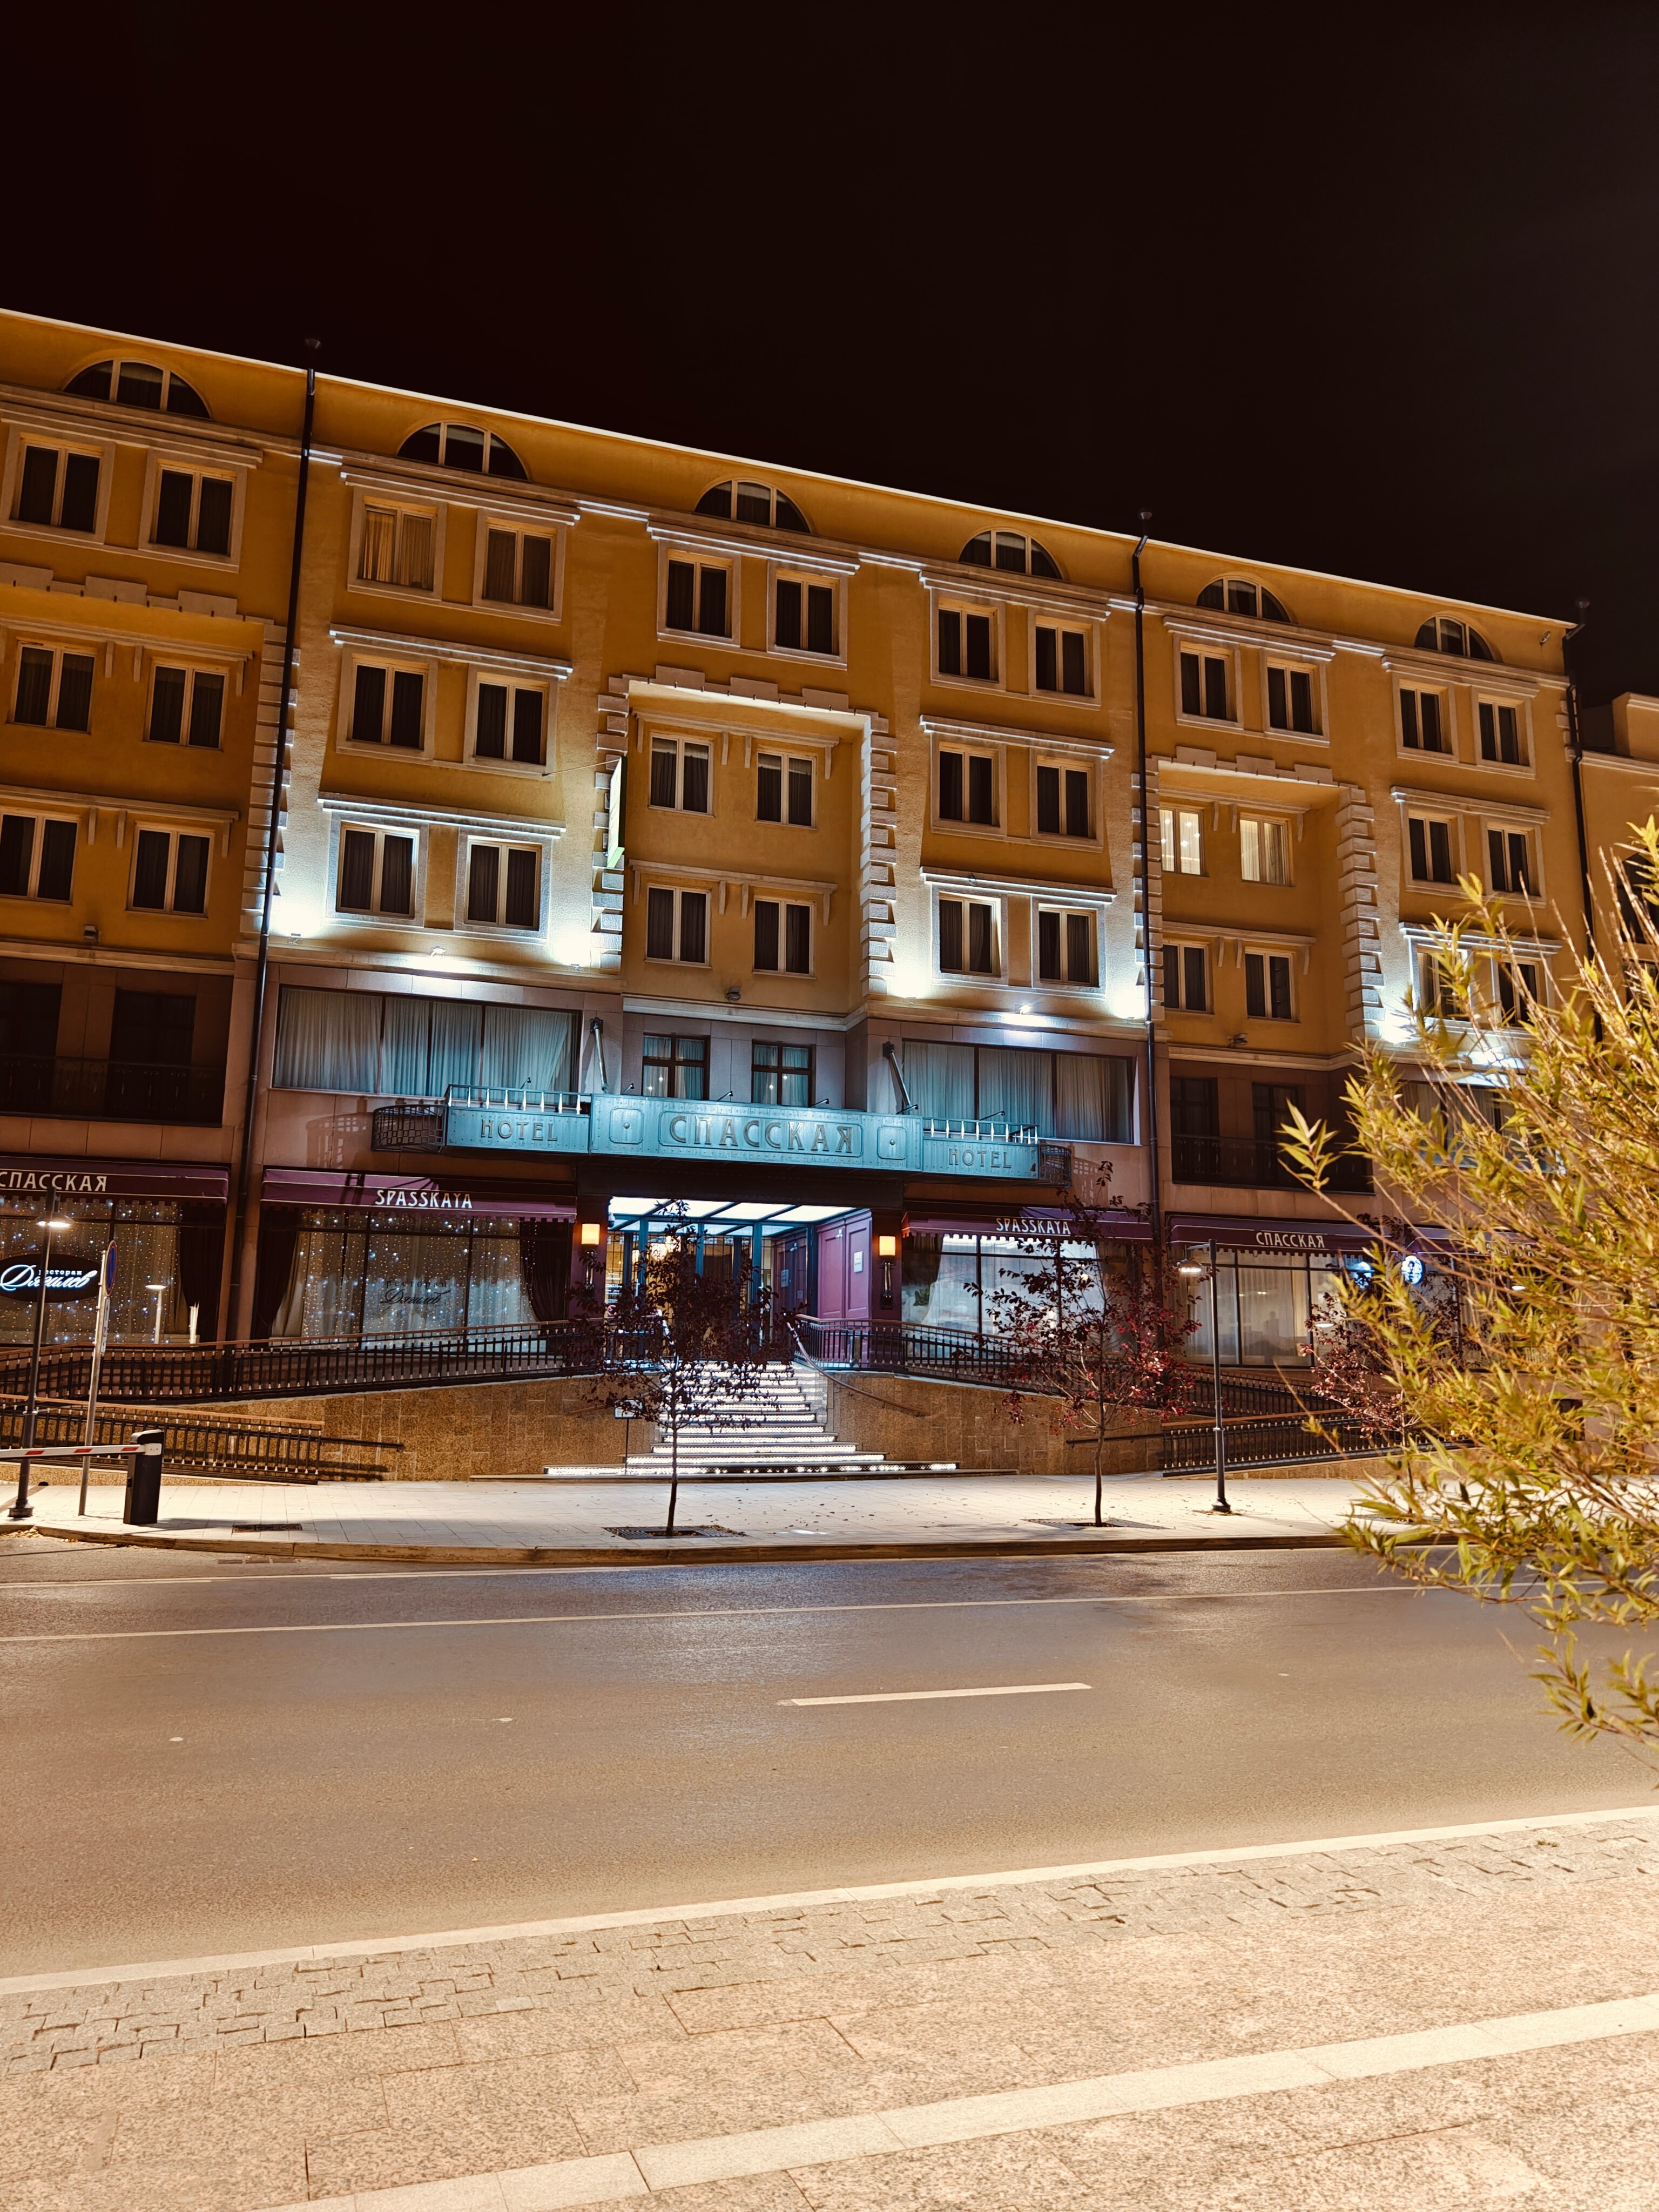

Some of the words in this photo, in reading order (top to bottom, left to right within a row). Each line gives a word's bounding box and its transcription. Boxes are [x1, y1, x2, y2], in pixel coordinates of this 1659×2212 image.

[481, 1118, 558, 1142] HOTEL
[669, 1115, 853, 1154] СПАССКАЯ
[948, 1148, 1011, 1169] HOTEL
[0, 1171, 107, 1192] СПАССКАЯ
[375, 1190, 473, 1209] SPASSKAYA
[996, 1218, 1071, 1235] SPASSKAYA
[1256, 1232, 1325, 1248] СПАССКАЯ
